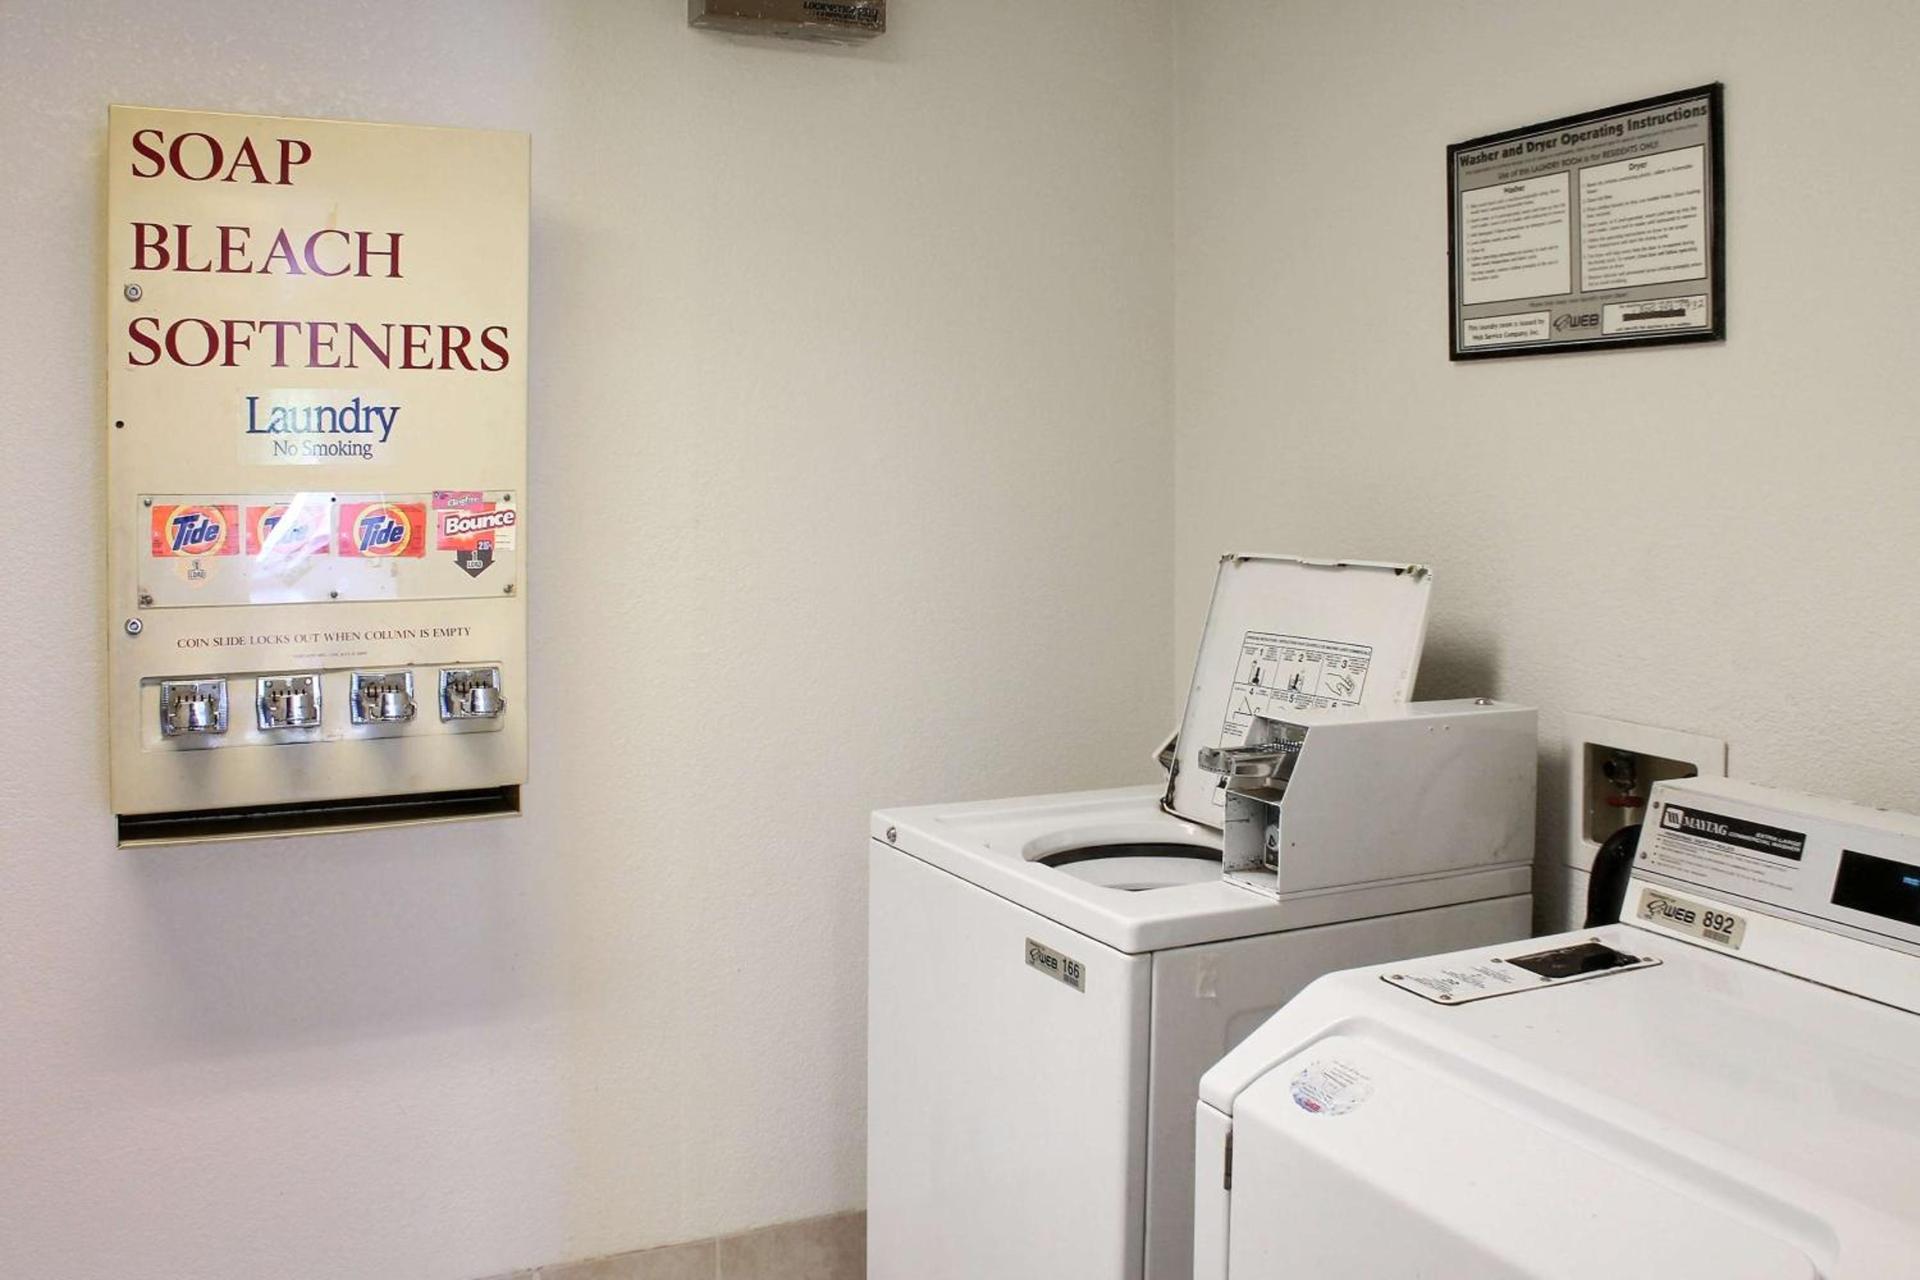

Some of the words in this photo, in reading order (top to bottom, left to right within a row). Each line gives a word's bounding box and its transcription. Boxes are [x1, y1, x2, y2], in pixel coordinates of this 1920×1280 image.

[1460, 150, 1499, 167] Washer
[1502, 143, 1523, 159] and
[1526, 138, 1557, 155] Dryer
[1561, 121, 1624, 145] Operating
[1627, 104, 1708, 131] Instructions
[132, 129, 312, 185] SOAP
[1628, 161, 1648, 171] Dryer
[130, 222, 404, 278] BLEACH
[1570, 313, 1599, 327] WEB
[127, 317, 510, 372] SOFTENERS
[245, 396, 400, 442] Laundry
[273, 440, 298, 457] No
[302, 440, 374, 460] Smoking
[172, 513, 220, 551] Tide
[359, 515, 405, 551] Tide
[445, 510, 515, 535] Bounce
[177, 638, 210, 649] COIN
[213, 636, 246, 647] SLIDE
[249, 634, 290, 646] LOCKS
[294, 633, 321, 643] OUT
[323, 631, 361, 643] WHEN
[364, 629, 416, 641] COLUMN
[420, 628, 430, 639] IS
[433, 626, 471, 638] EMPTY
[1683, 816, 1728, 836] MAYTAG
[1663, 905, 1696, 924] WEB
[1703, 911, 1735, 934] 892
[1039, 953, 1058, 970] WEB
[1062, 958, 1080, 979] 166
